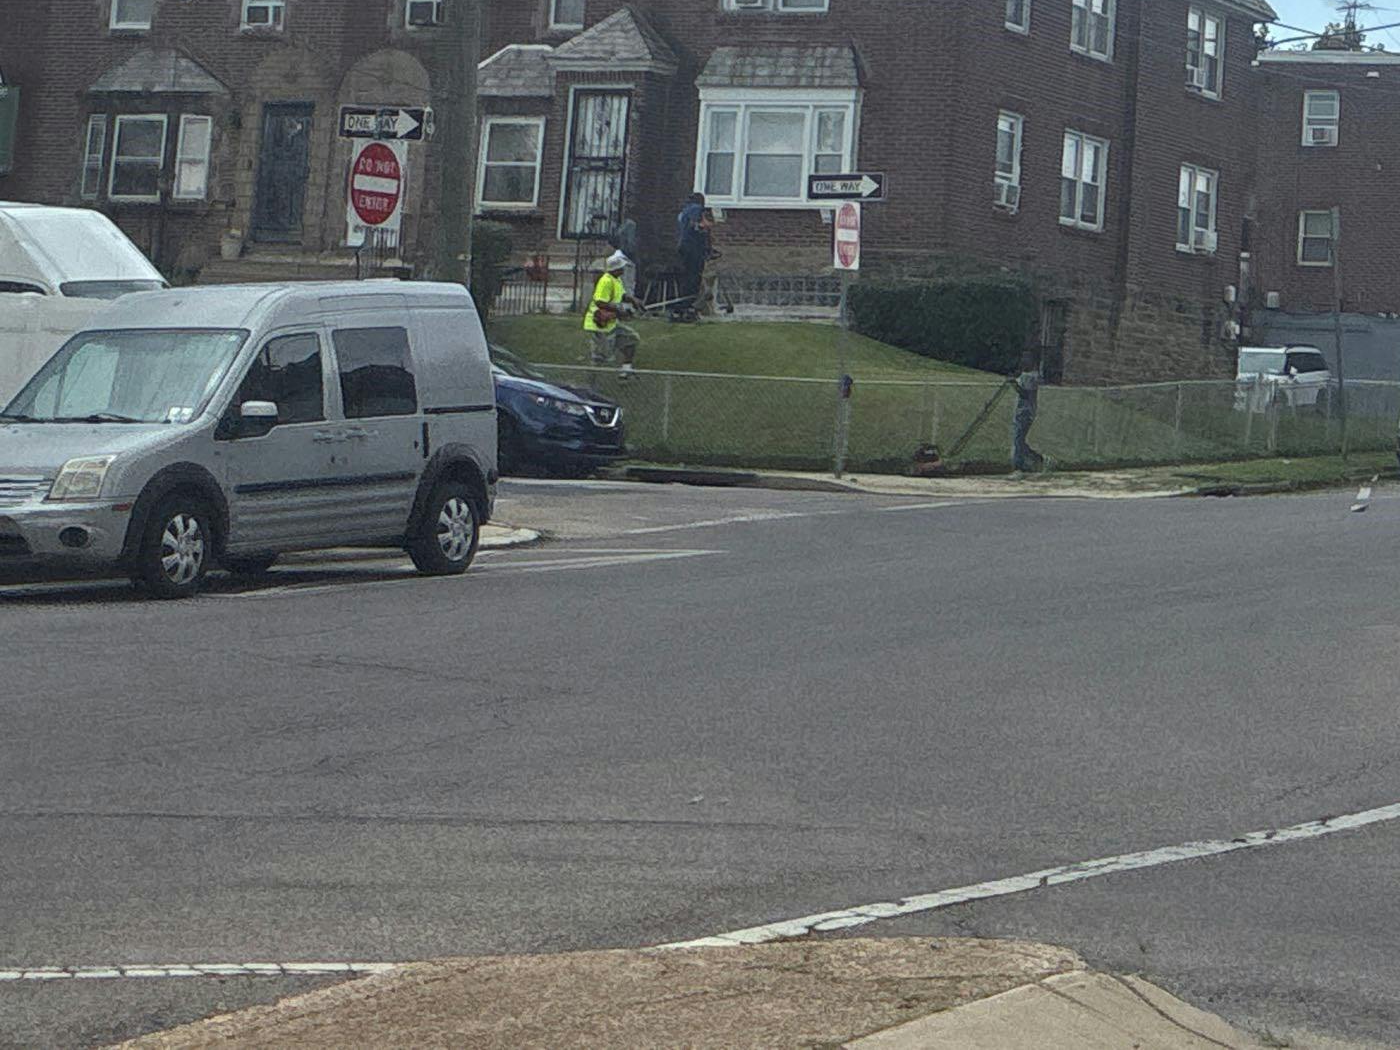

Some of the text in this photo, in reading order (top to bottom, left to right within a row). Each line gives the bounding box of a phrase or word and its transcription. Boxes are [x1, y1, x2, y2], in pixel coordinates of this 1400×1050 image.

[348, 116, 398, 130] ONE AY
[815, 180, 860, 192] ONE WAY
